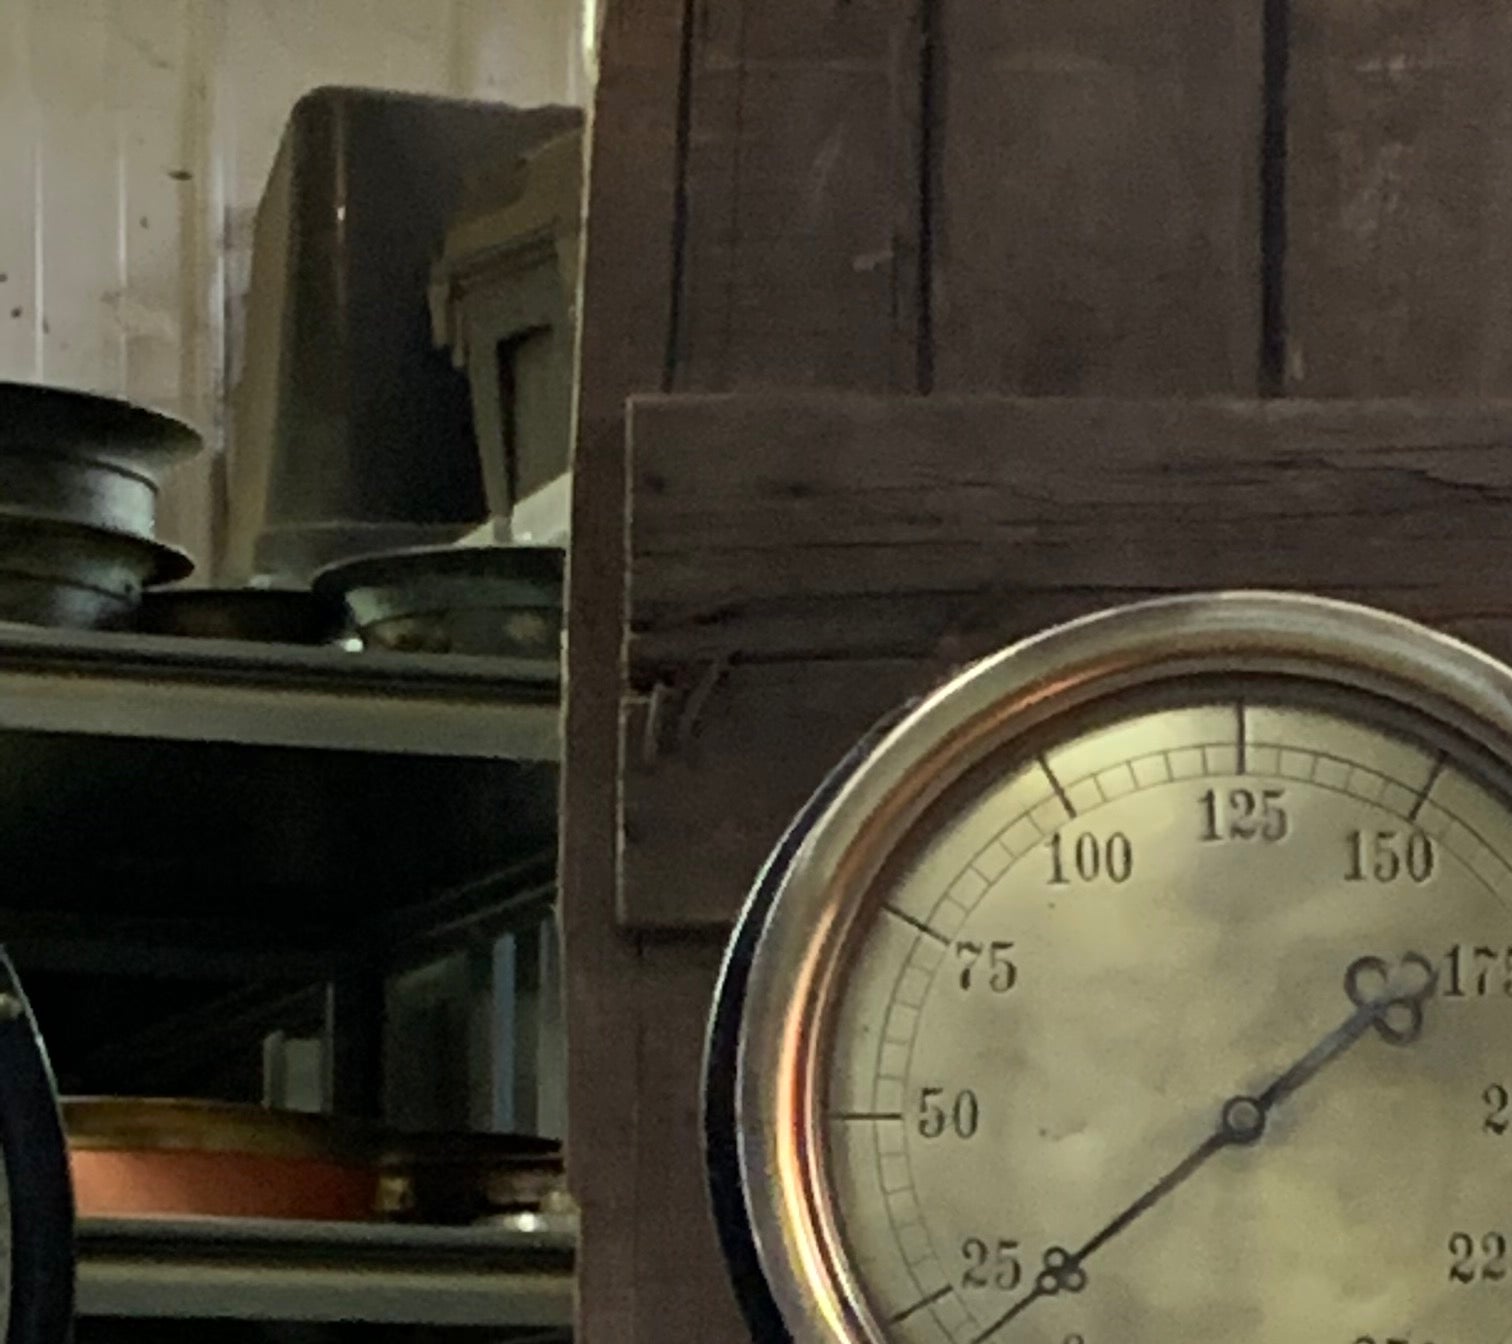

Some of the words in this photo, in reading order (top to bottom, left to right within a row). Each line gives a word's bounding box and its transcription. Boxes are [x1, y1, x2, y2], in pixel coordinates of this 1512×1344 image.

[1198, 788, 1289, 843] 125
[1043, 827, 1134, 886] 100
[1343, 829, 1434, 884] 150
[956, 940, 1018, 994] 75
[917, 1086, 980, 1140] 50
[961, 1237, 1023, 1291] 25
